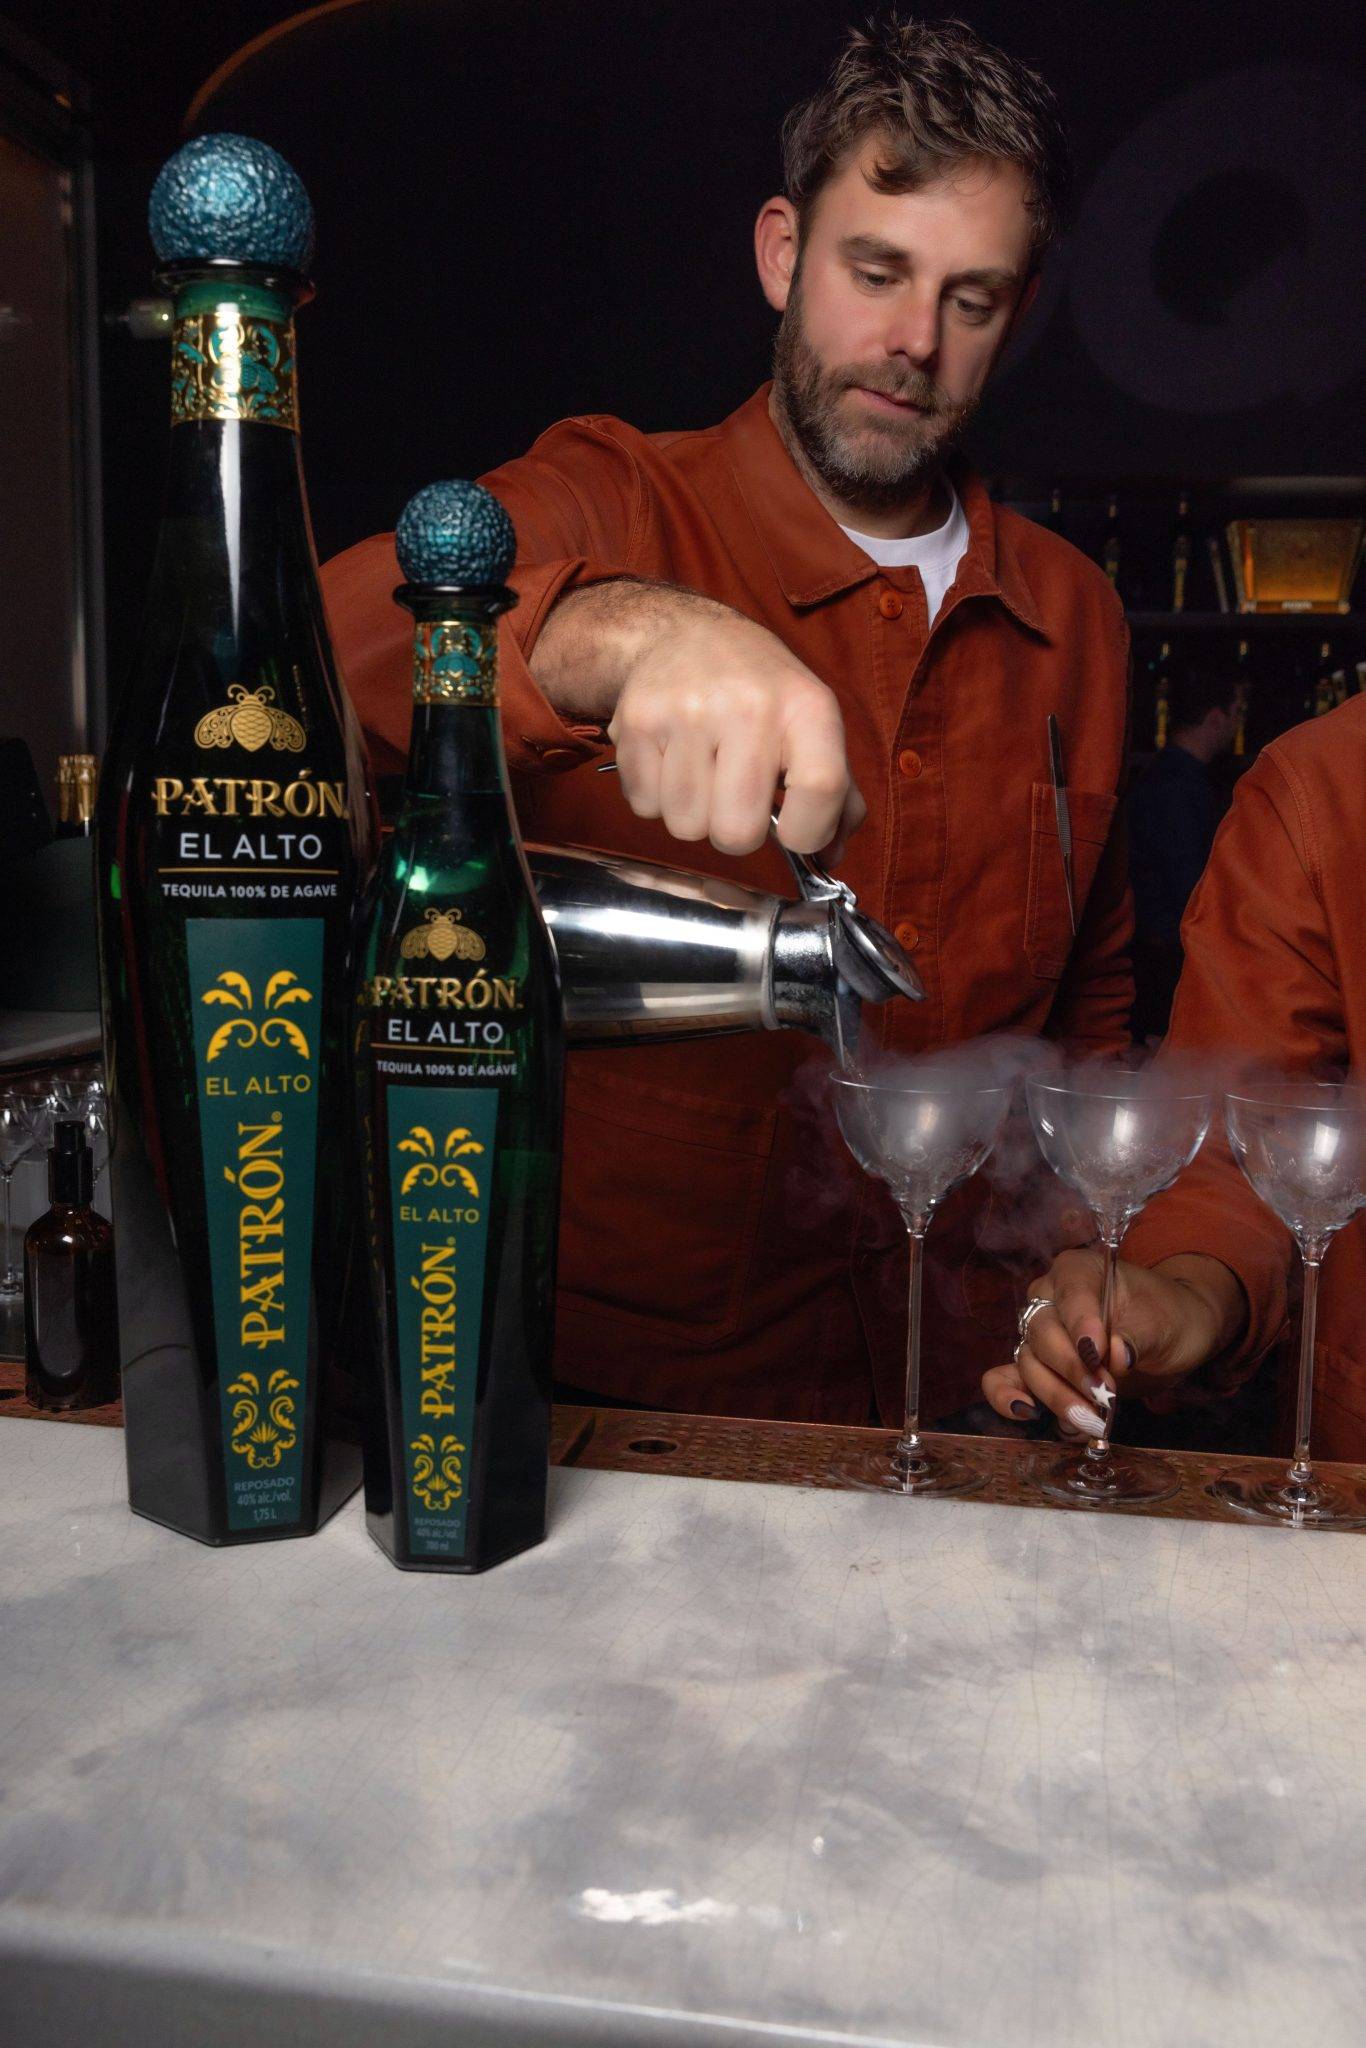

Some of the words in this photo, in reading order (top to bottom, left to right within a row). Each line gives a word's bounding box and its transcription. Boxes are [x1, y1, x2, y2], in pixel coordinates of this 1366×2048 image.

[180, 832, 222, 859] EL
[232, 833, 323, 860] ALTO
[161, 883, 227, 898] TEQUILA
[230, 885, 266, 898] 100%
[270, 885, 290, 898] DE
[293, 884, 338, 898] AGAVE
[388, 1018, 420, 1043] EL
[427, 1021, 504, 1044] ALTO
[376, 1060, 423, 1076] TEQUILA
[425, 1063, 455, 1076] 100%
[458, 1064, 475, 1077] DE
[477, 1063, 518, 1076] AGAVE
[206, 1077, 237, 1096] EL
[245, 1074, 311, 1095] ALTO
[400, 1206, 422, 1222] EL
[427, 1207, 480, 1224] ALTO
[234, 1476, 296, 1492] REPOSADO
[236, 1492, 256, 1506] 40%
[271, 1507, 278, 1520] L
[414, 1517, 462, 1528] REPOSADO
